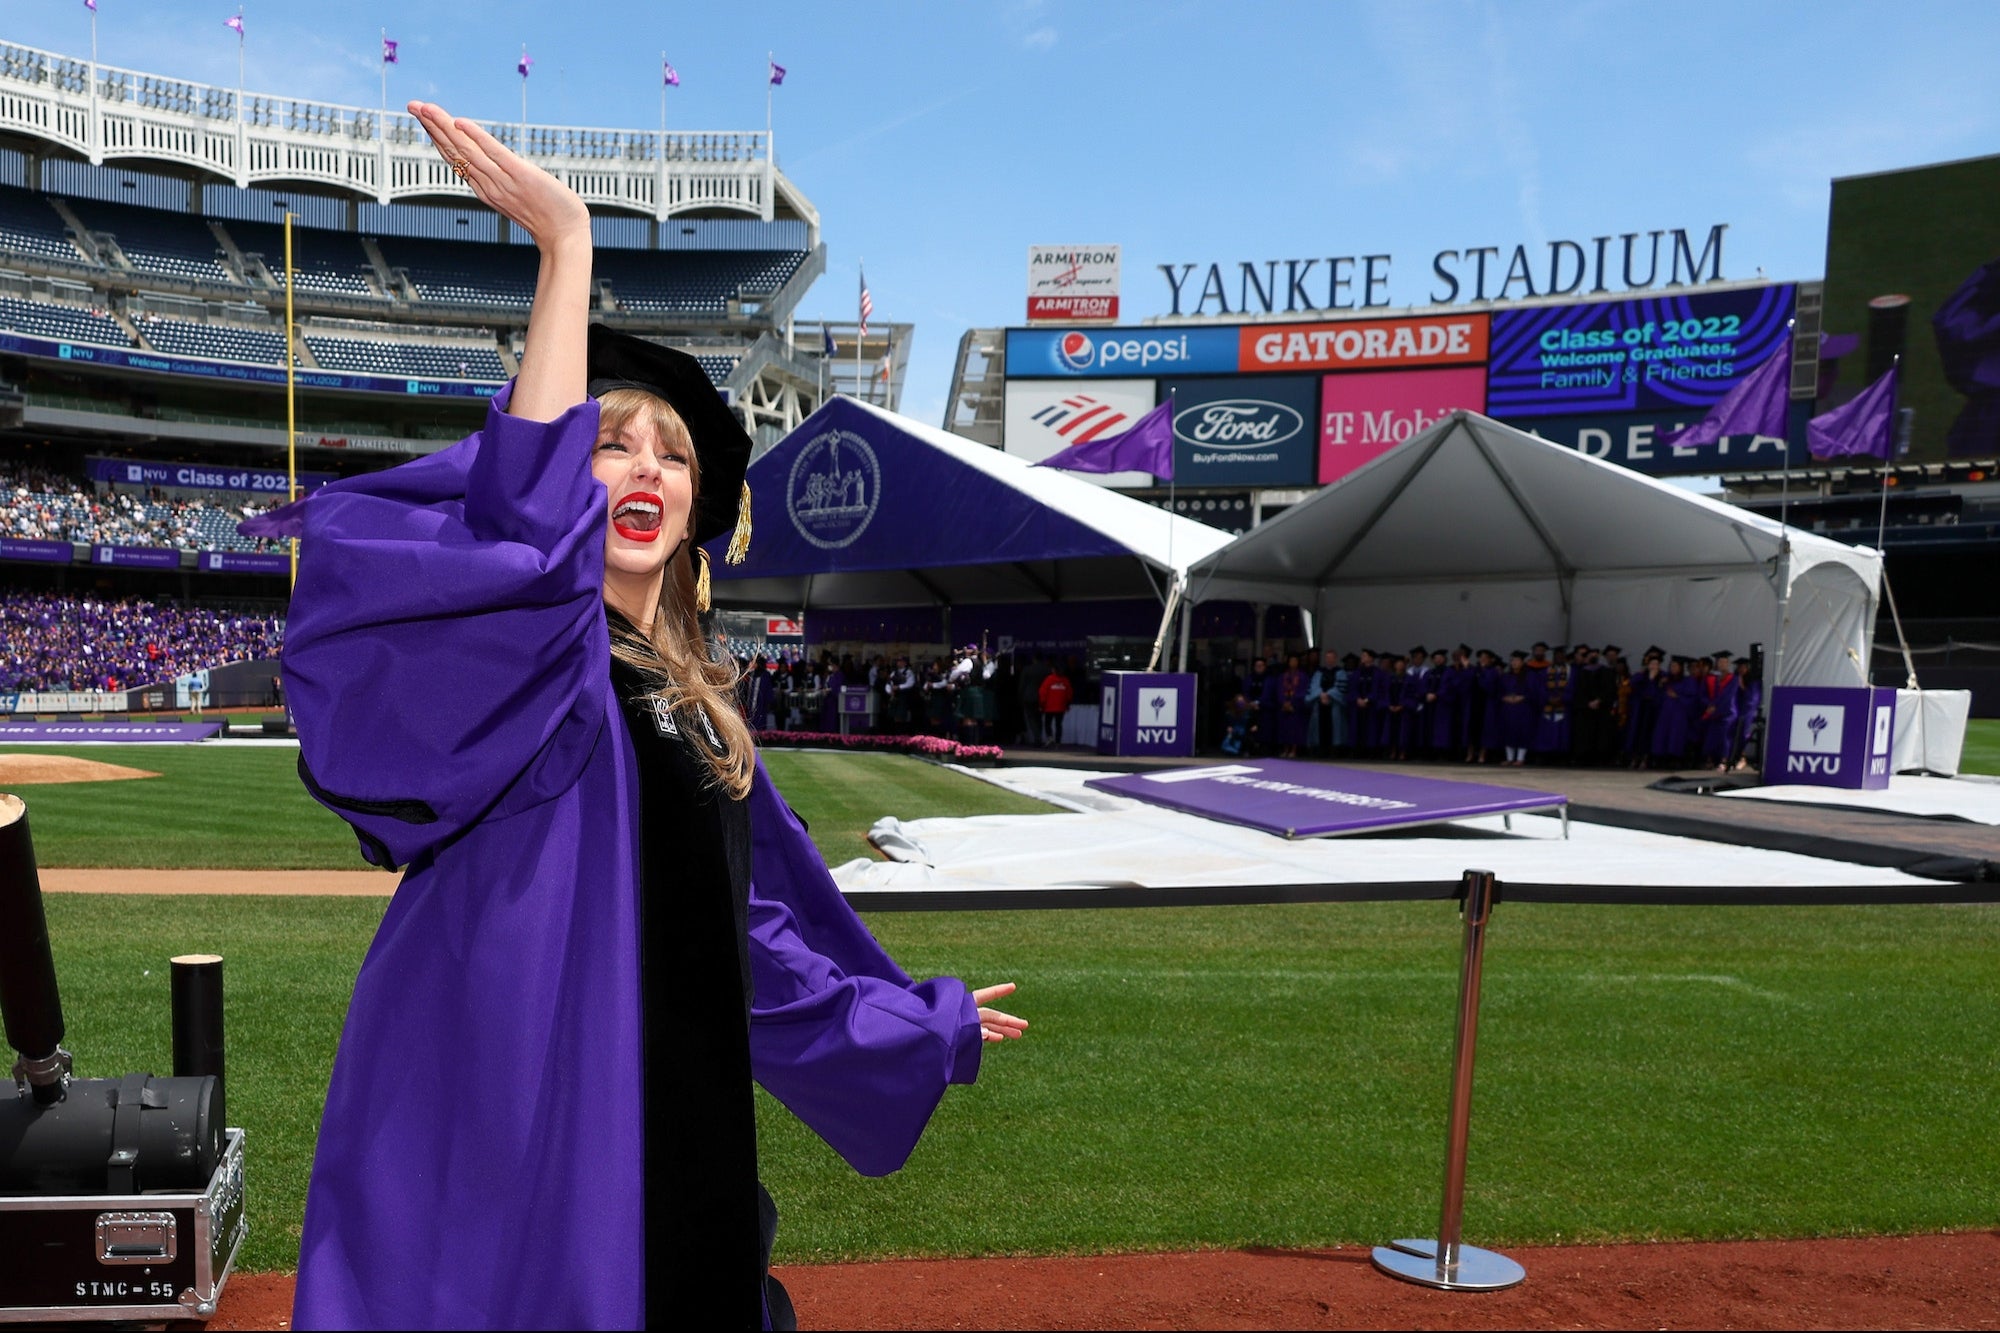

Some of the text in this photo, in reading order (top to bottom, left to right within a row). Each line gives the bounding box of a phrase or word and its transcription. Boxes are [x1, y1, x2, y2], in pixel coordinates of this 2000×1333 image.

[1033, 252, 1116, 264] ARMITRON
[1158, 224, 1728, 317] YANKEE STADIUM
[1035, 298, 1111, 310] ARMITRON
[1540, 315, 1740, 351] Class of 2022
[1100, 335, 1187, 367] pepsi
[1255, 324, 1472, 363] GATORADE
[72, 349, 94, 360] NYU
[128, 355, 170, 369] Welcome
[1540, 342, 1737, 368] Welcome Graduates,
[1541, 359, 1734, 389] Family & Friends
[419, 384, 440, 394] NYU
[1194, 405, 1280, 441] Ford
[318, 436, 348, 448] Audi
[1192, 452, 1279, 464] BuyFordNow.com
[143, 469, 168, 481] NYU
[176, 469, 225, 486] Class
[229, 473, 249, 488] of
[1136, 729, 1177, 744] NYU
[1786, 754, 1841, 775] NYU
[1870, 757, 1887, 776] NYU
